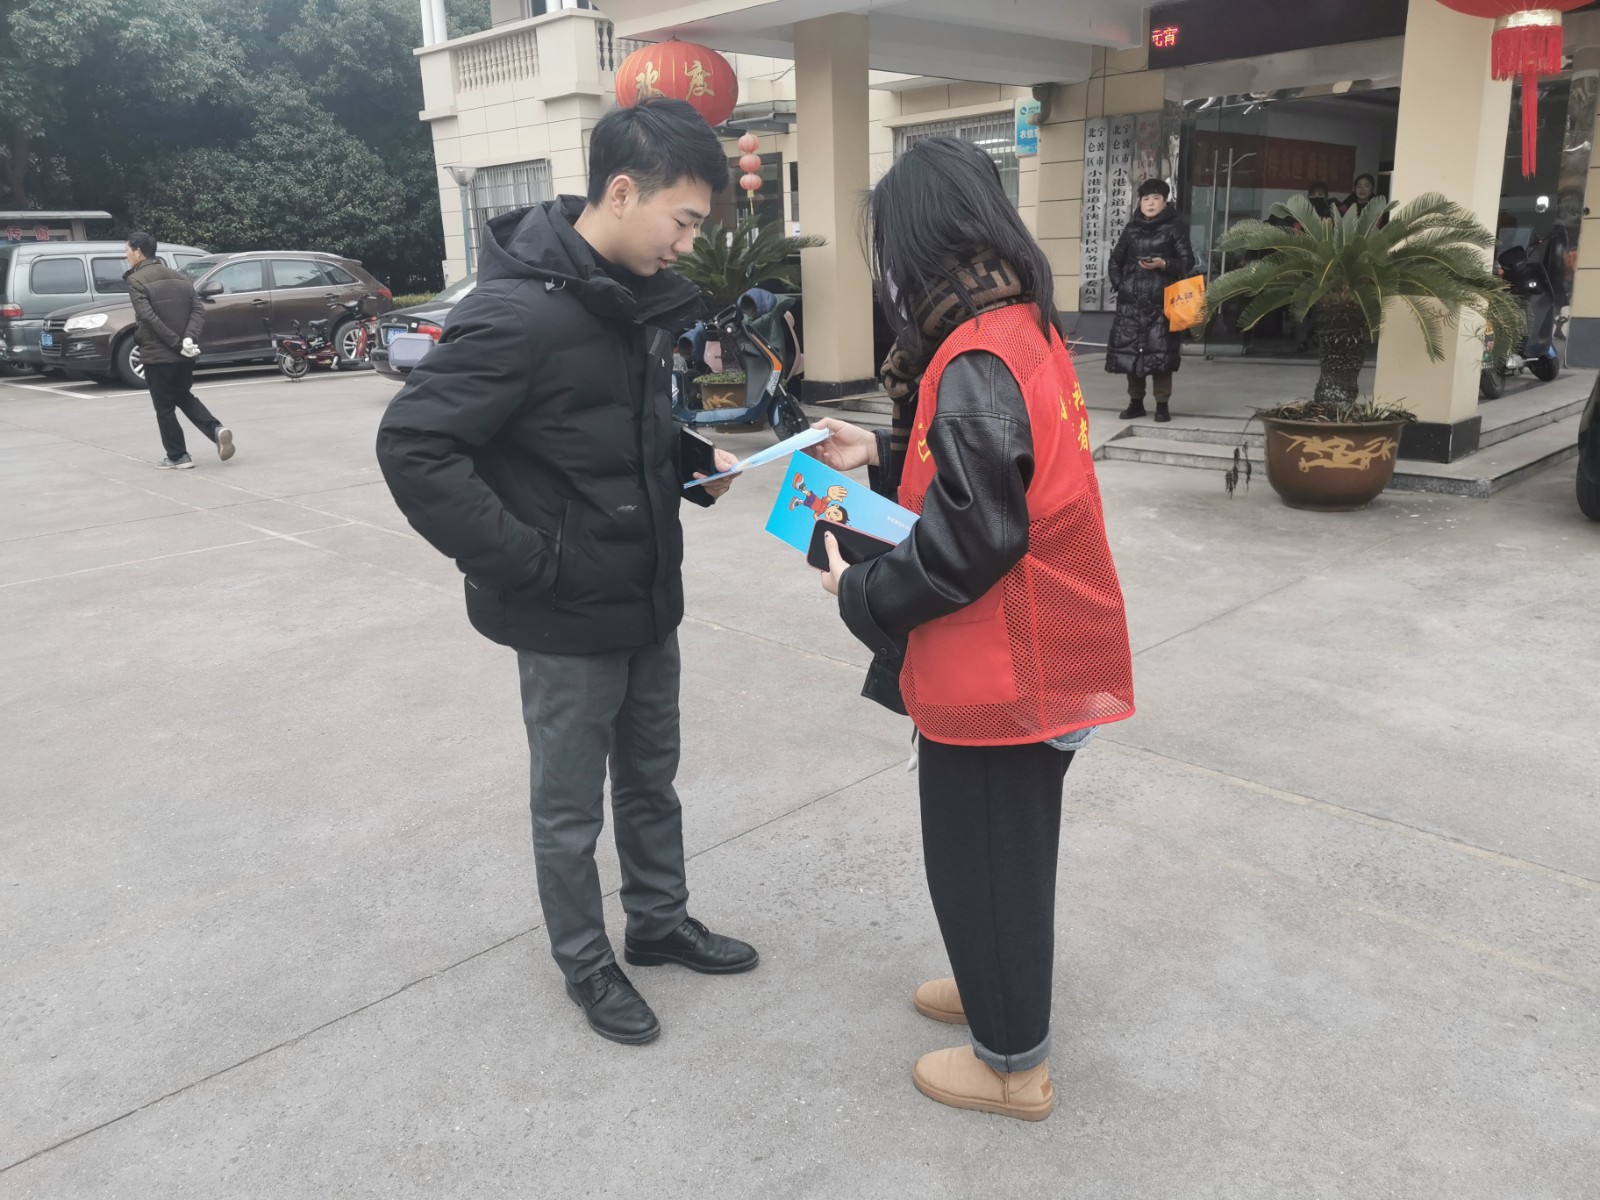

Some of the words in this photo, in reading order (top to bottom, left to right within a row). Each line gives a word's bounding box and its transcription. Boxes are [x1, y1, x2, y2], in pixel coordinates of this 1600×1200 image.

[1152, 26, 1177, 45] 元宵
[1087, 127, 1096, 167] 北仑区
[1097, 126, 1105, 166] 宁波市
[1111, 124, 1121, 165] 北仑区
[1122, 123, 1131, 164] 宁波市
